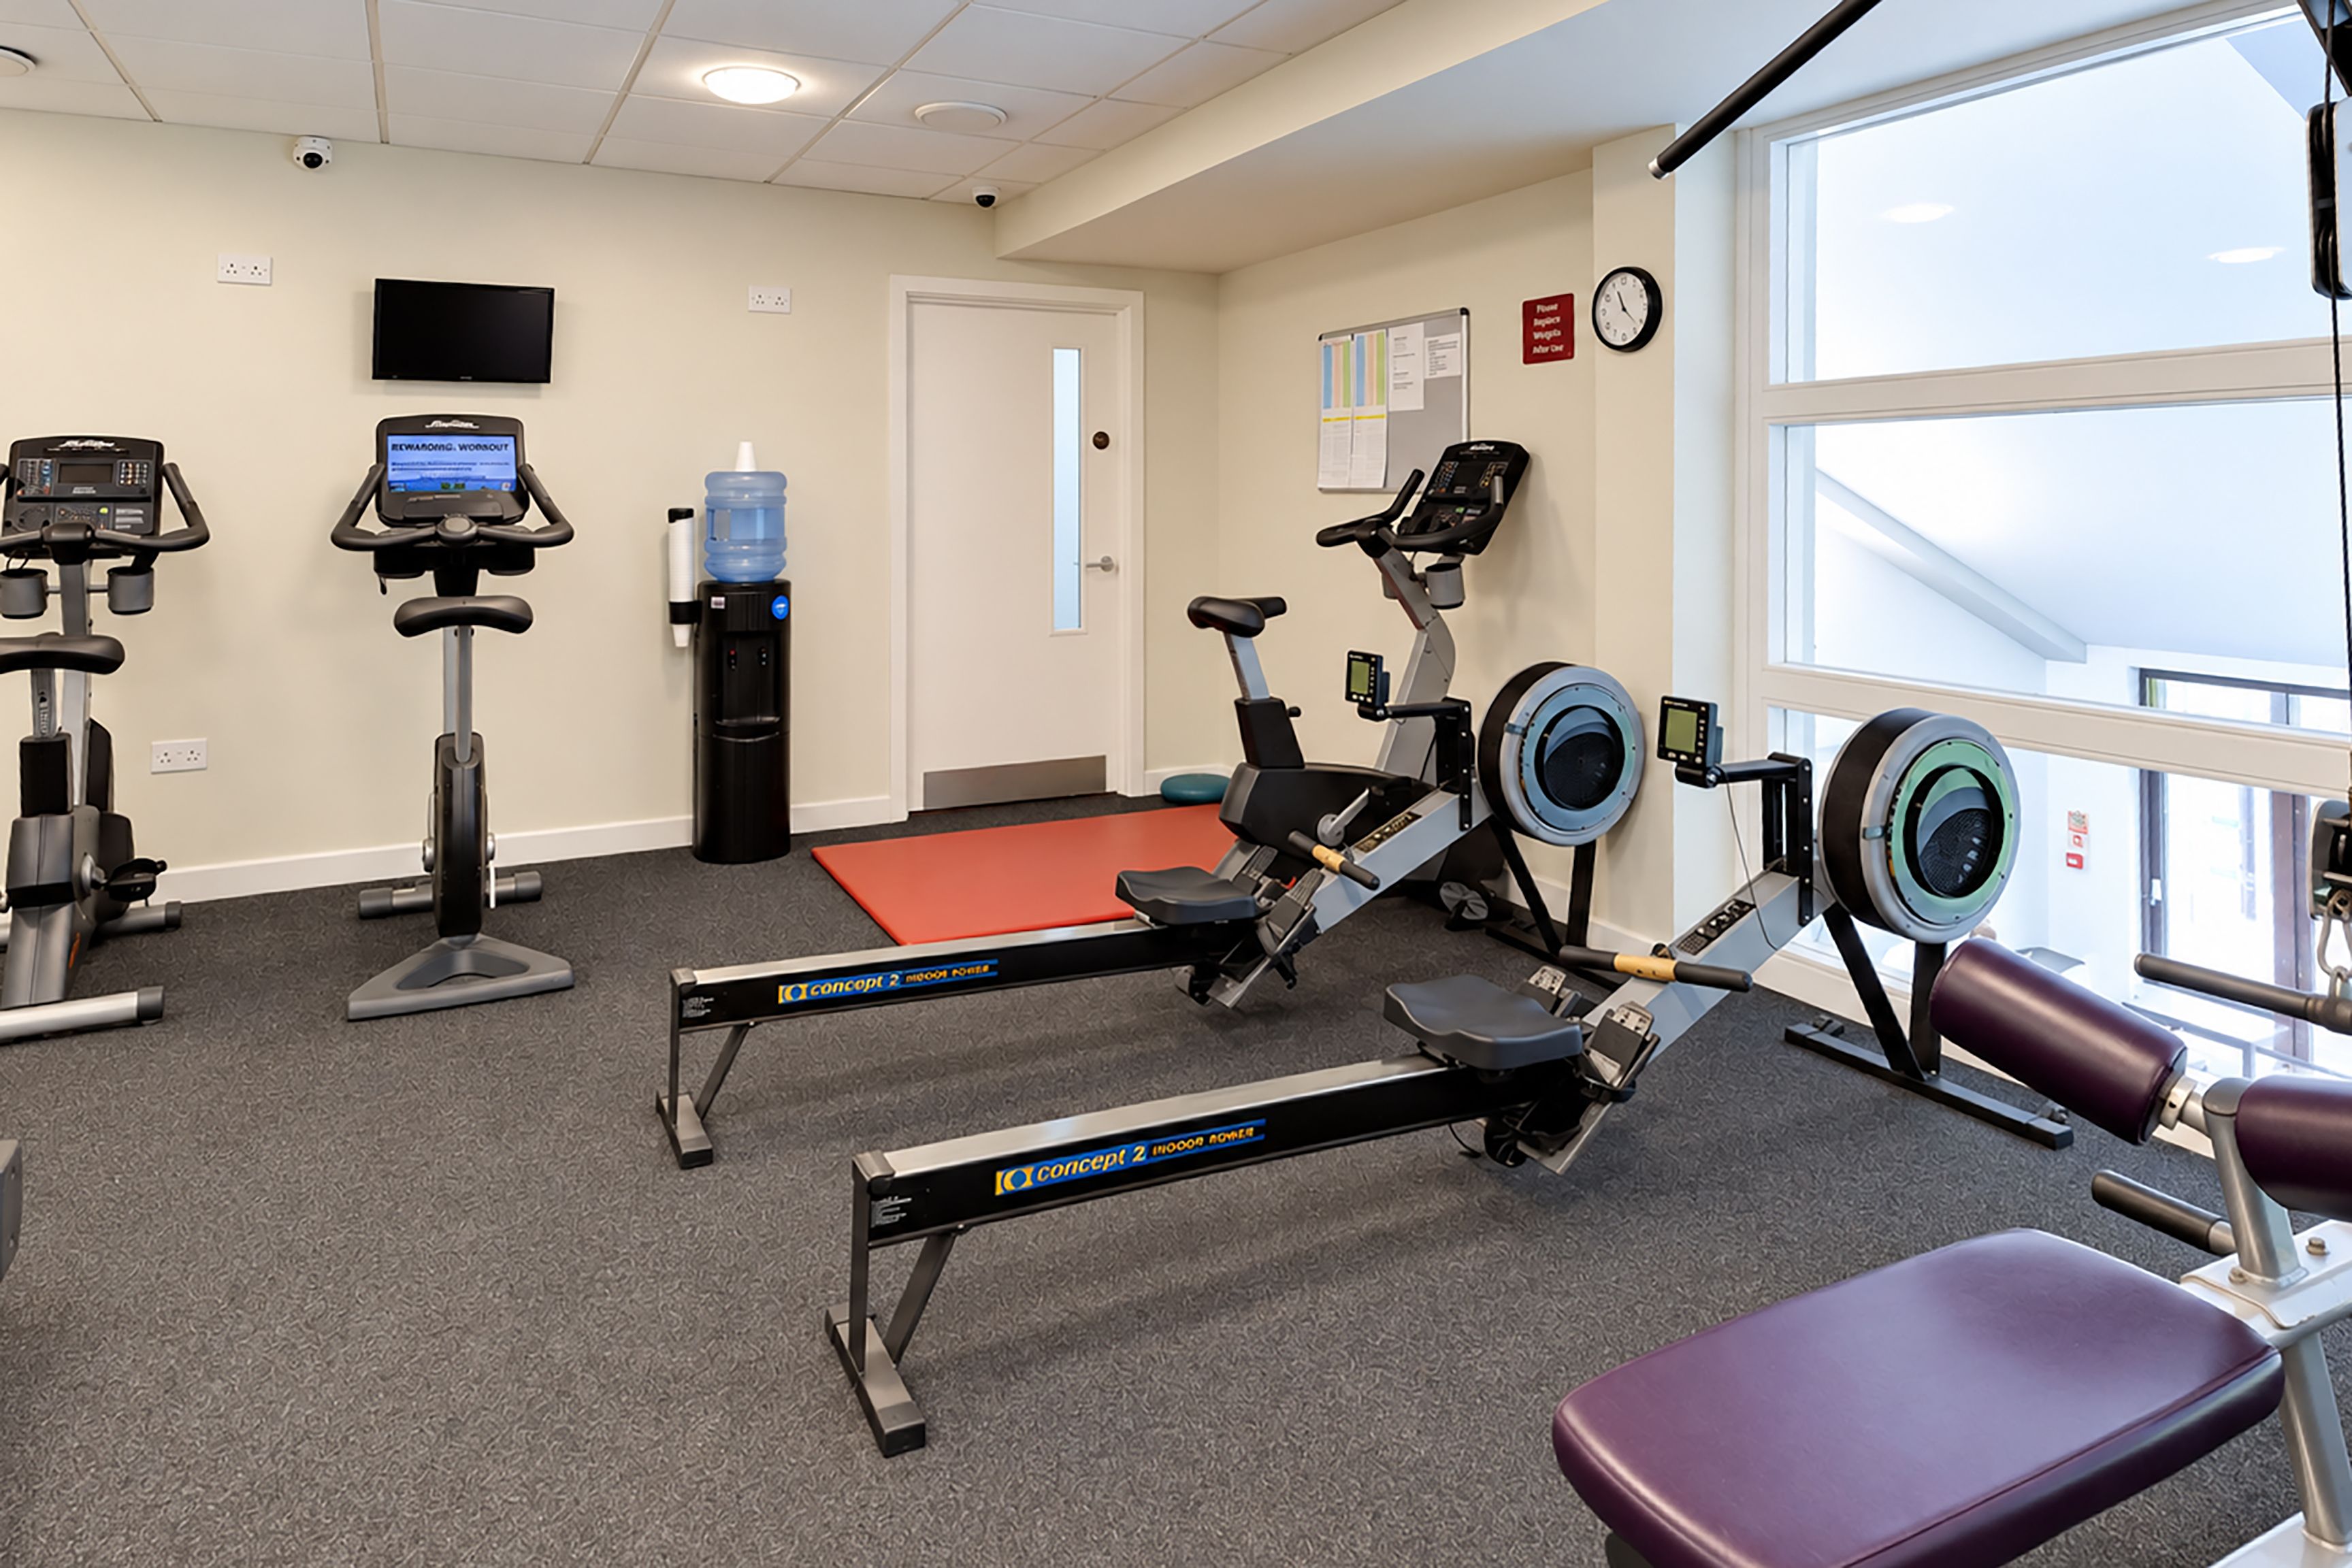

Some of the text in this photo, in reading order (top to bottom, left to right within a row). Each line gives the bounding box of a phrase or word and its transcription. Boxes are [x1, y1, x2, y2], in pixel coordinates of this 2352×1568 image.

[889, 973, 899, 987] 2
[1036, 1149, 1126, 1182] concept
[1132, 1145, 1146, 1162] 2
